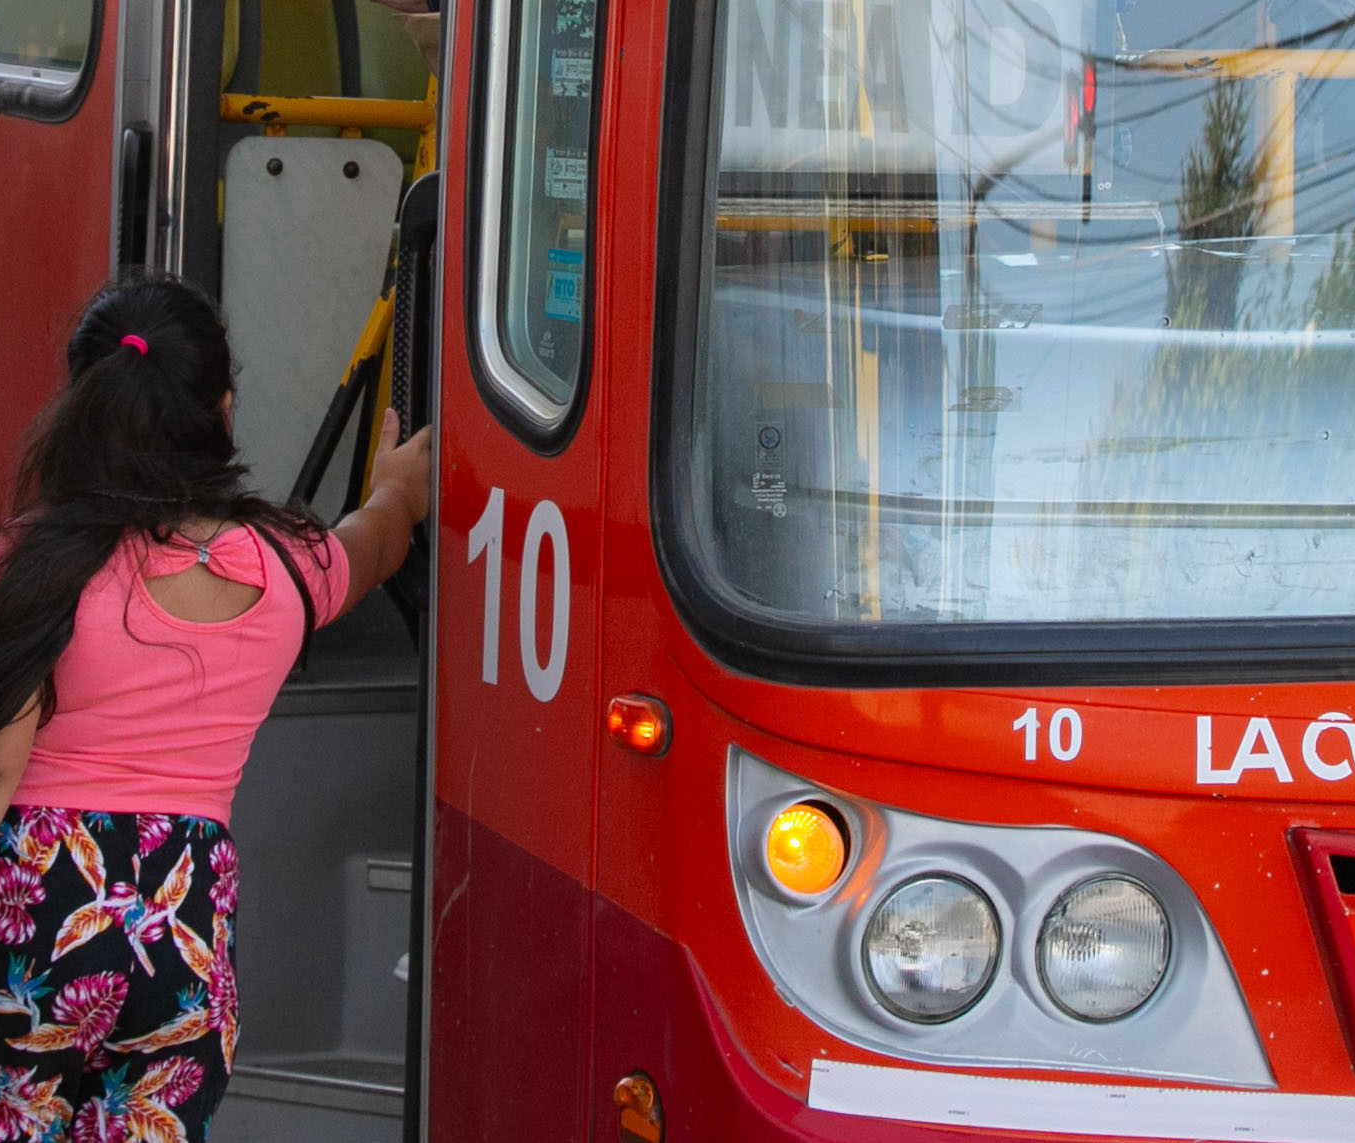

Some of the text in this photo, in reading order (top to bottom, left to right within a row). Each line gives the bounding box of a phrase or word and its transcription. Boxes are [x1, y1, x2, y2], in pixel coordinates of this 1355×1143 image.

[467, 486, 571, 703] 10
[1013, 707, 1082, 761] 10
[1196, 715, 1294, 784] LA
